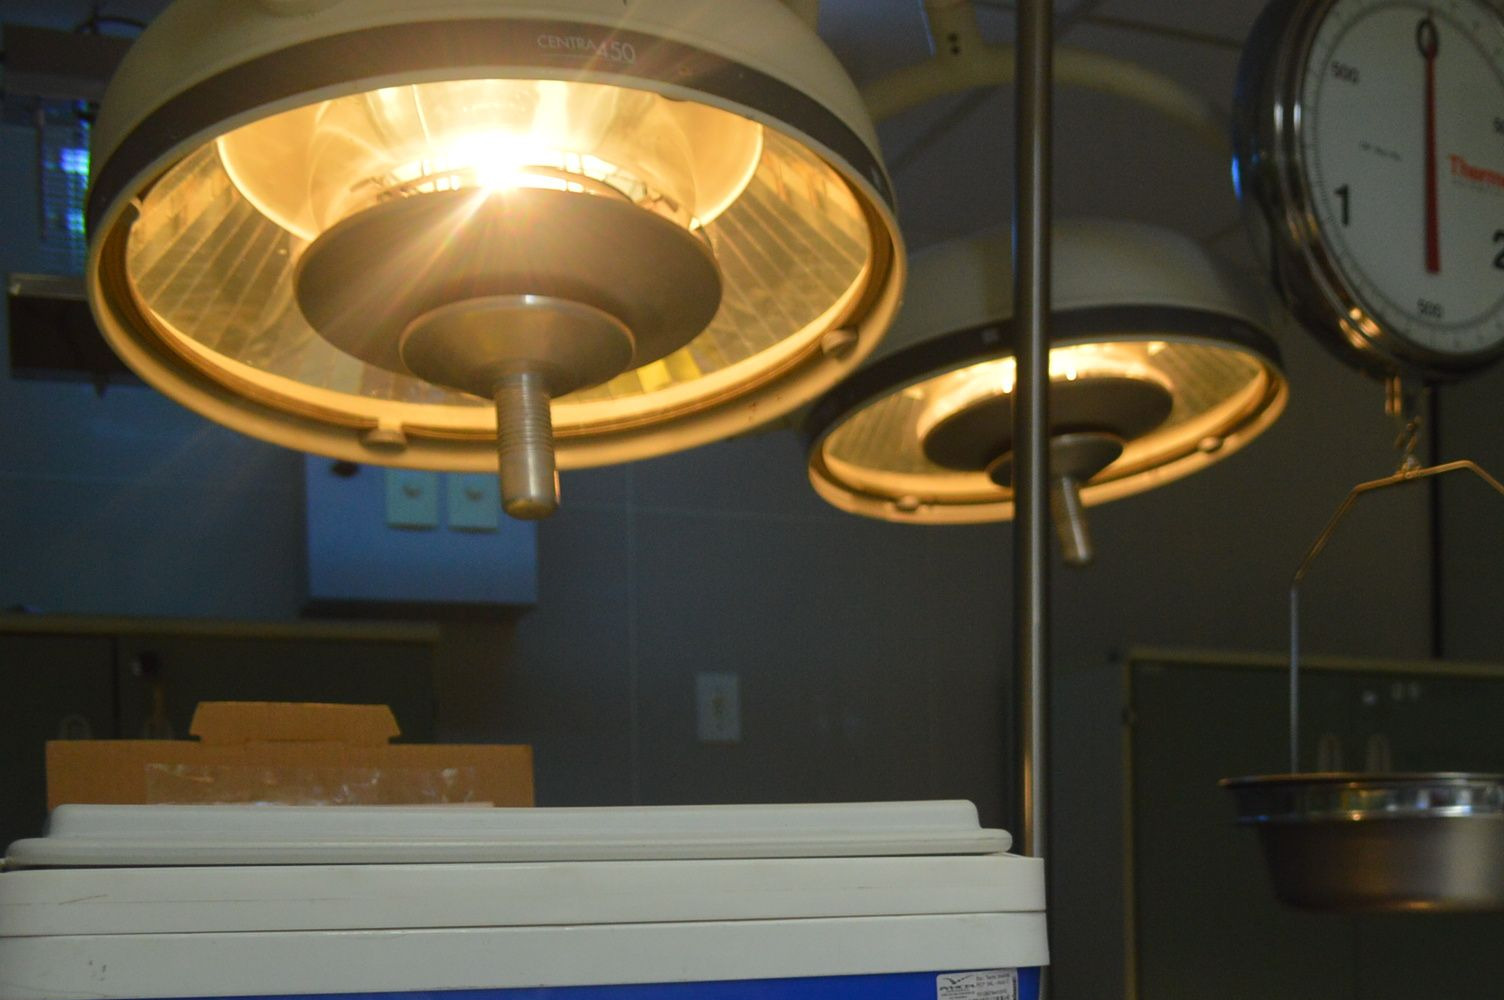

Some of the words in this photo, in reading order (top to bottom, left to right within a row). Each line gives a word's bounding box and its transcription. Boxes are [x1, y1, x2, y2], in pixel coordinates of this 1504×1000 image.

[537, 34, 597, 51] CENTRA
[597, 41, 636, 64] 450
[1416, 18, 1439, 59] 0
[1332, 61, 1360, 84] 500
[1334, 184, 1351, 227] 1
